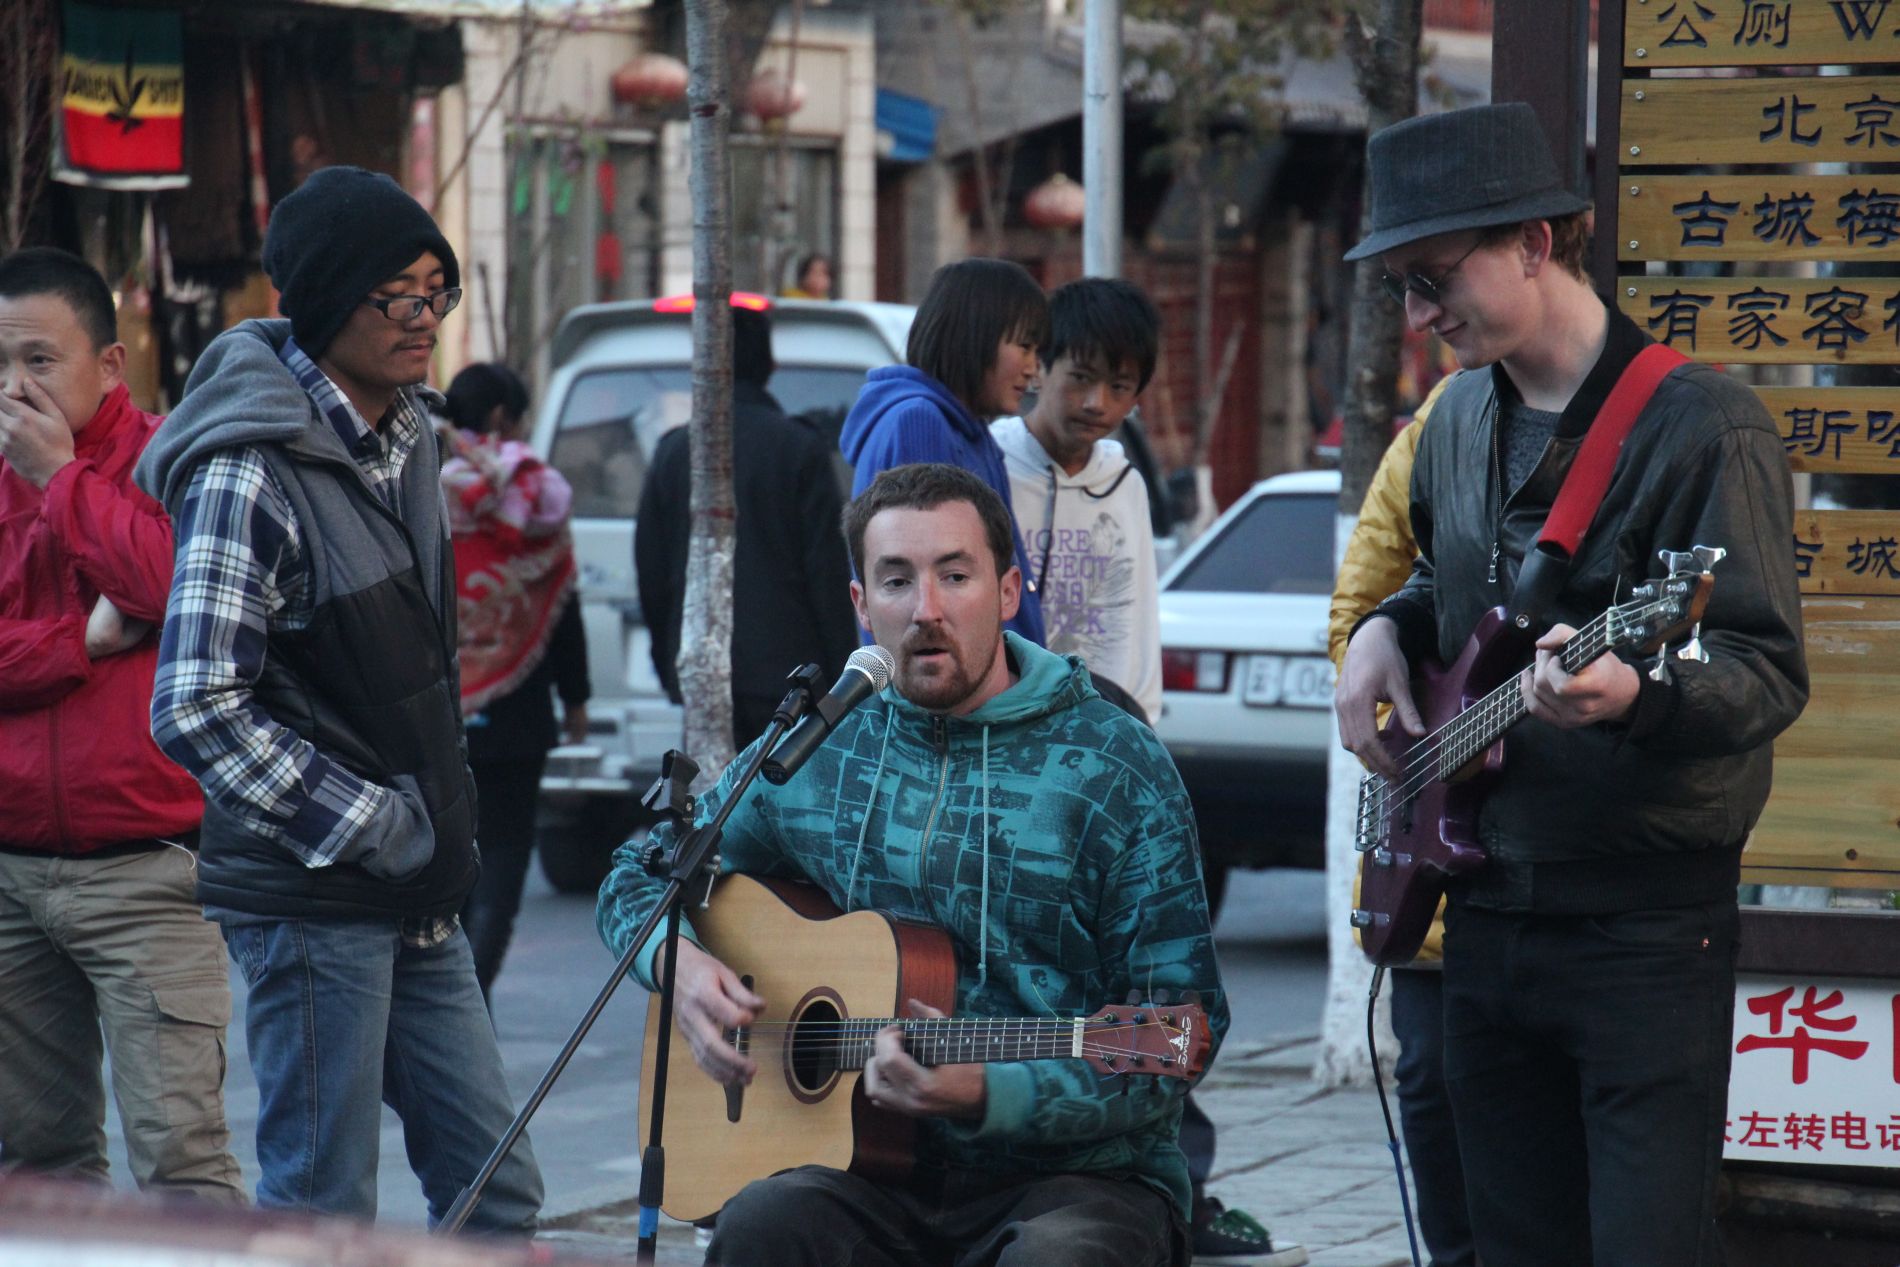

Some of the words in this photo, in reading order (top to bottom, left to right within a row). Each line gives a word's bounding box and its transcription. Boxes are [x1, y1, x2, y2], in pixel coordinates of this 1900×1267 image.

[1657, 1, 1791, 49] 公厕
[1760, 94, 1900, 147] 北京
[1736, 985, 1900, 1085] 华
[1724, 1110, 1900, 1152] 左转电话
